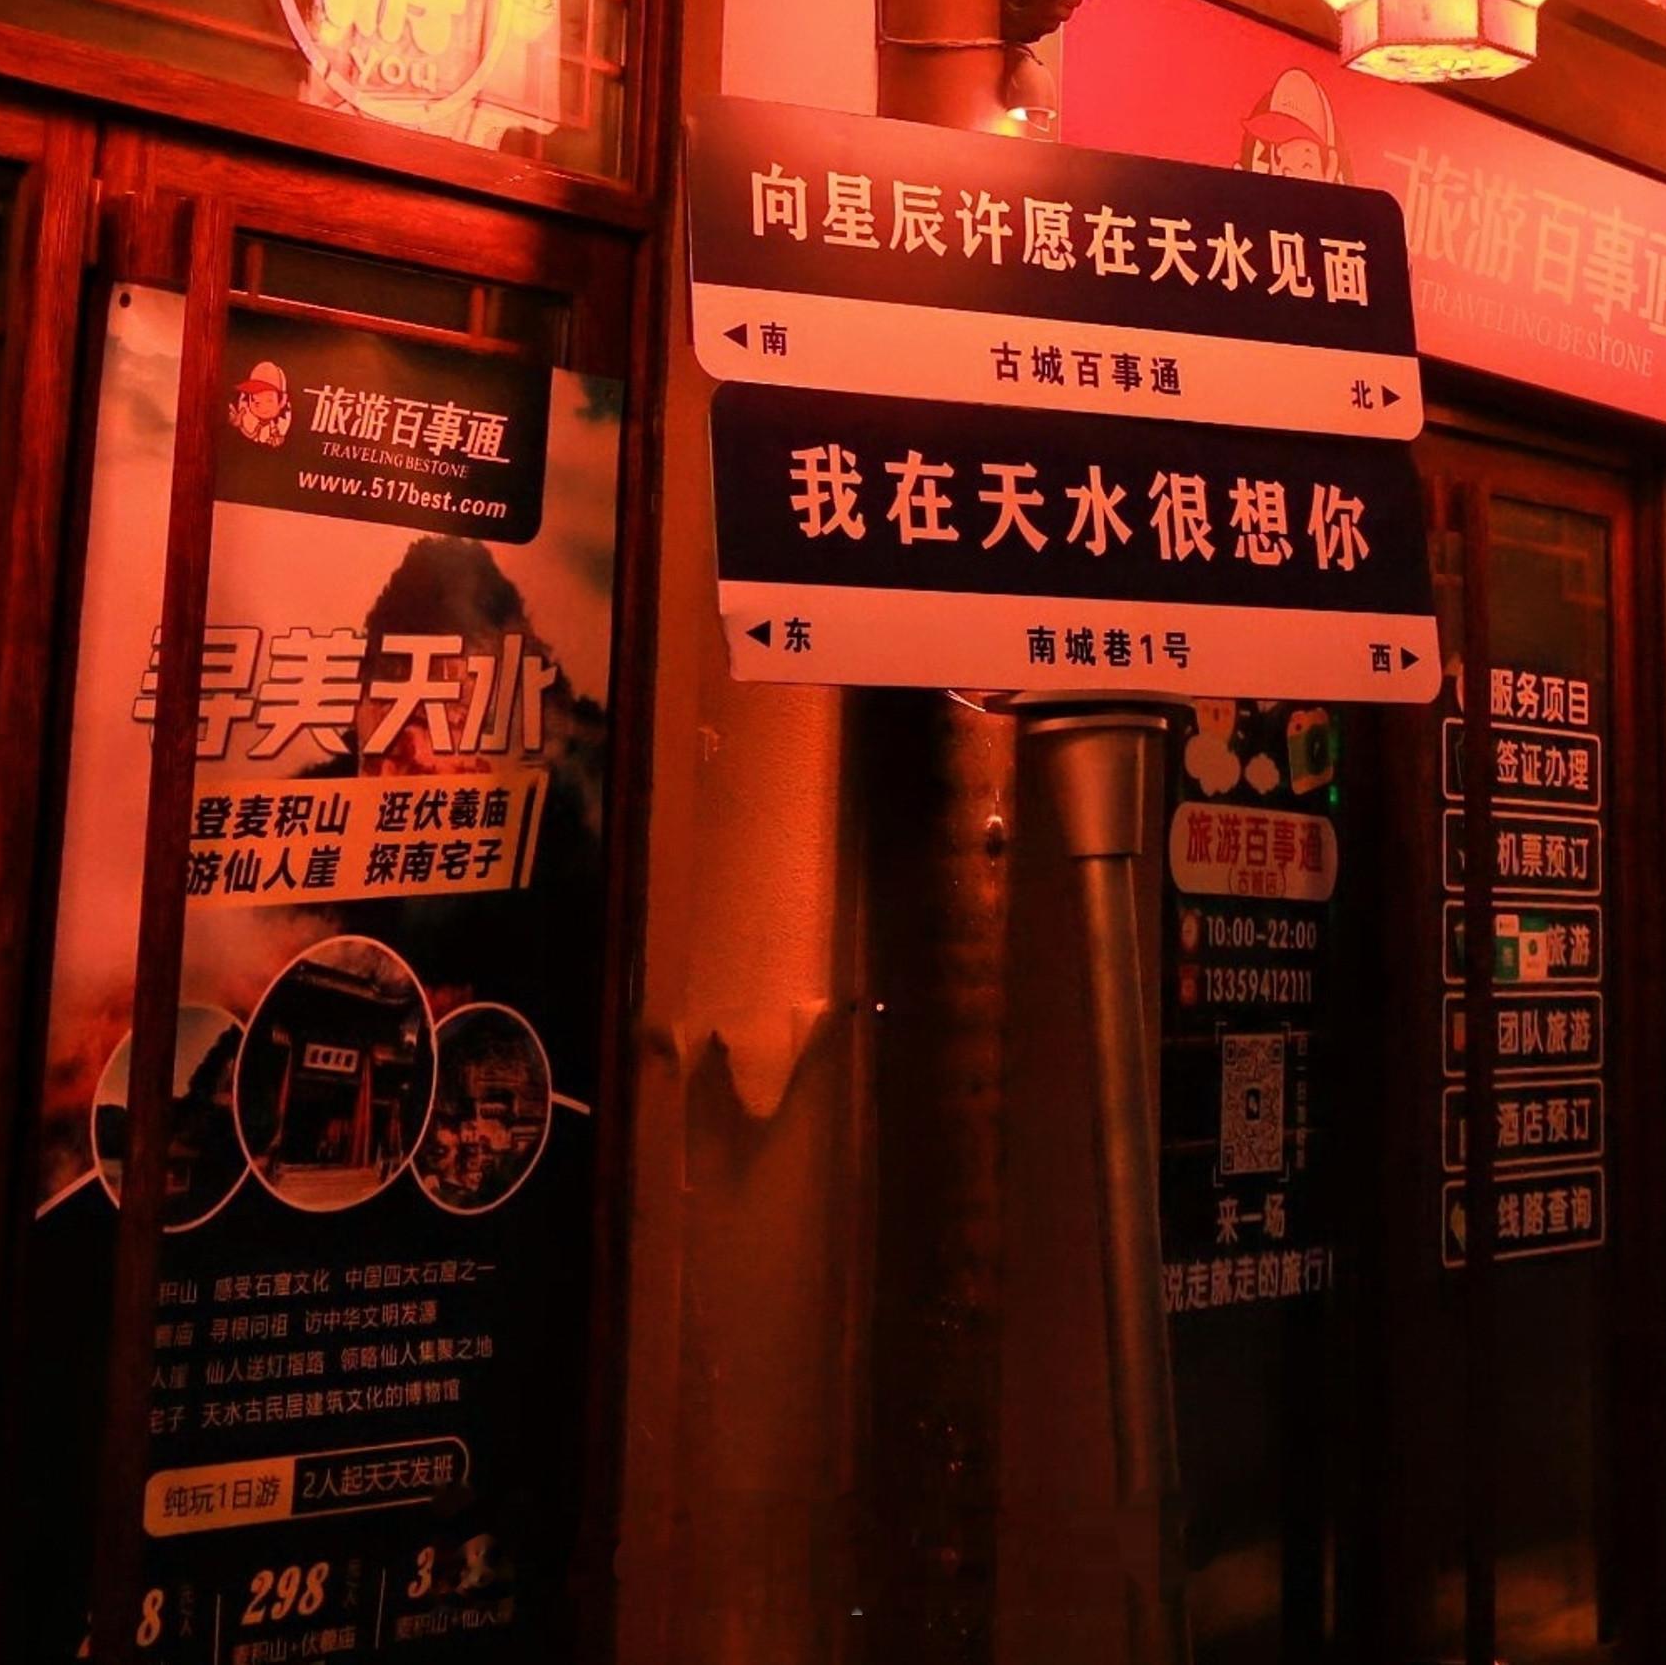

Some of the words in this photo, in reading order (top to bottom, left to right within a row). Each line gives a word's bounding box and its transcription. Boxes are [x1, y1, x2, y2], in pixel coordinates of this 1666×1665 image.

[348, 46, 439, 93] you
[749, 163, 1370, 307] 向星辰许愿在天水见面
[760, 322, 789, 357] 南
[1419, 279, 1554, 349] TRAVELING
[1557, 328, 1654, 380] BESTONE
[989, 341, 1184, 397] 古城百事通
[1351, 380, 1374, 410] 北
[303, 384, 510, 464] 旅游百事通
[321, 441, 404, 469] TRAVELING
[405, 454, 469, 479] BESTONE
[298, 469, 507, 519] www.517best.com
[789, 443, 1370, 573] 我在天水很想你
[783, 618, 812, 653] 东
[1026, 626, 1192, 670] 南城巷1号
[1371, 643, 1393, 674] 西
[1490, 668, 1590, 725] 服务项目
[1496, 740, 1590, 791] 签证办理
[190, 793, 351, 841] 登麦积山
[375, 788, 511, 834] 逛伏羲庙
[364, 839, 503, 886] 探南宅子
[1186, 810, 1323, 873] 旅游百事通
[1496, 832, 1590, 881] 机票预订
[1497, 1009, 1591, 1055] 团队旅游
[1497, 1098, 1591, 1147] 酒店预订
[1215, 1193, 1286, 1245] 来一场
[1496, 1186, 1593, 1239] 线路查询
[162, 1476, 281, 1518] 纯玩1日游
[241, 1561, 331, 1626] 298
